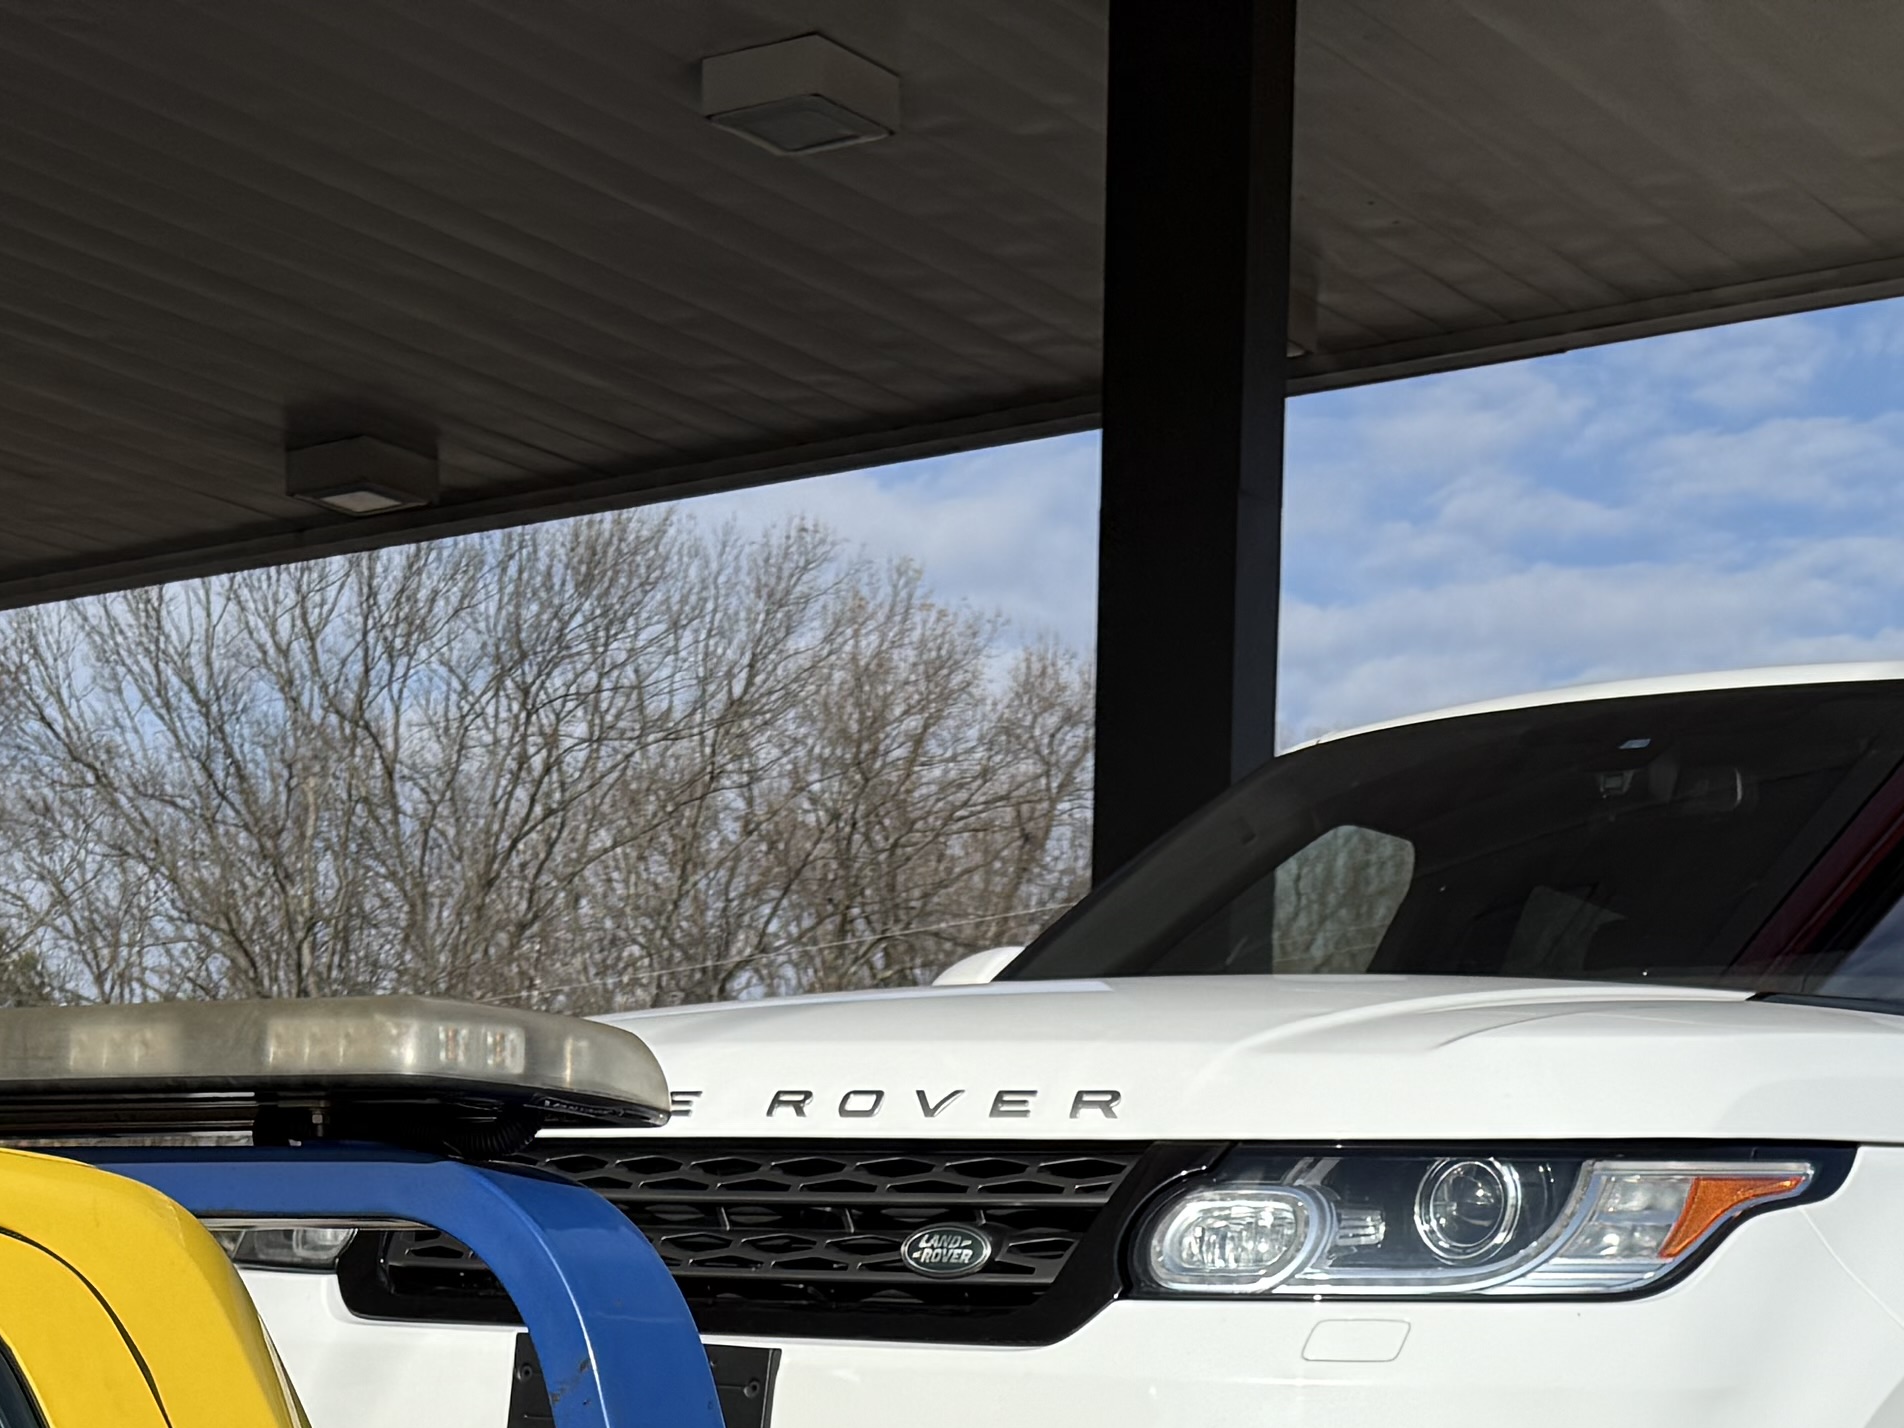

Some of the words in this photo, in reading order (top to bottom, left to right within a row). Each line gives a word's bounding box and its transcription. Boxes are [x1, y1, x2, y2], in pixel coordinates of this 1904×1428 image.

[766, 1089, 1122, 1119] ROVER
[919, 1234, 961, 1248] LAND
[921, 1248, 973, 1263] ROVER
